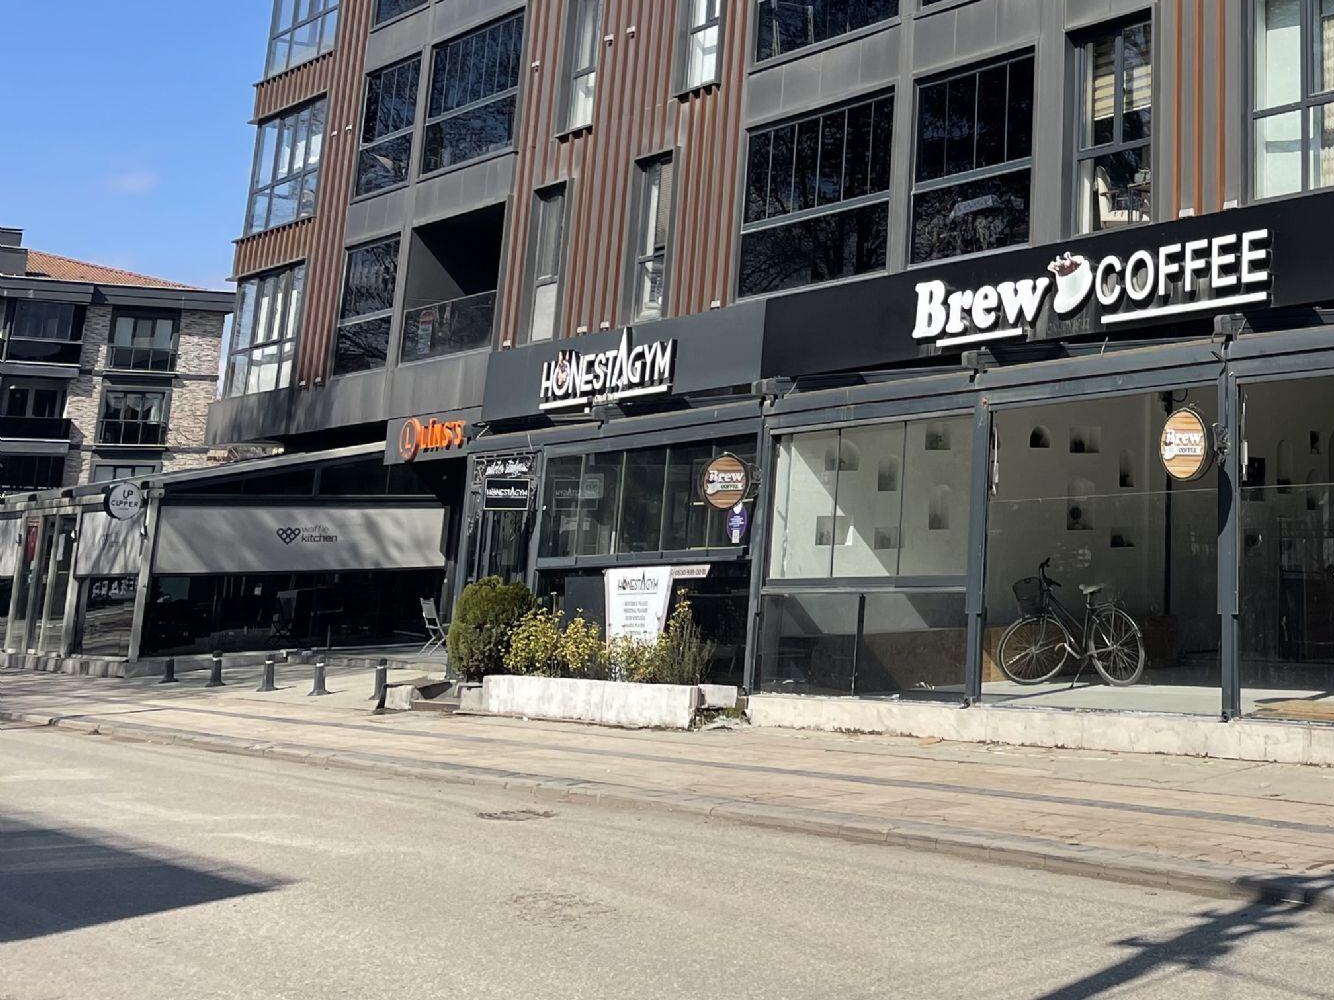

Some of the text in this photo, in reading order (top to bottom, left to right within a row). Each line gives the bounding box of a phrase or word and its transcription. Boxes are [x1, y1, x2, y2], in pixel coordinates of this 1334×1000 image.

[912, 229, 1268, 339] Brew COFFEE
[1166, 429, 1203, 445] Brew
[709, 470, 744, 482] Brew
[301, 525, 329, 533] waffle
[301, 534, 338, 542] kitchen
